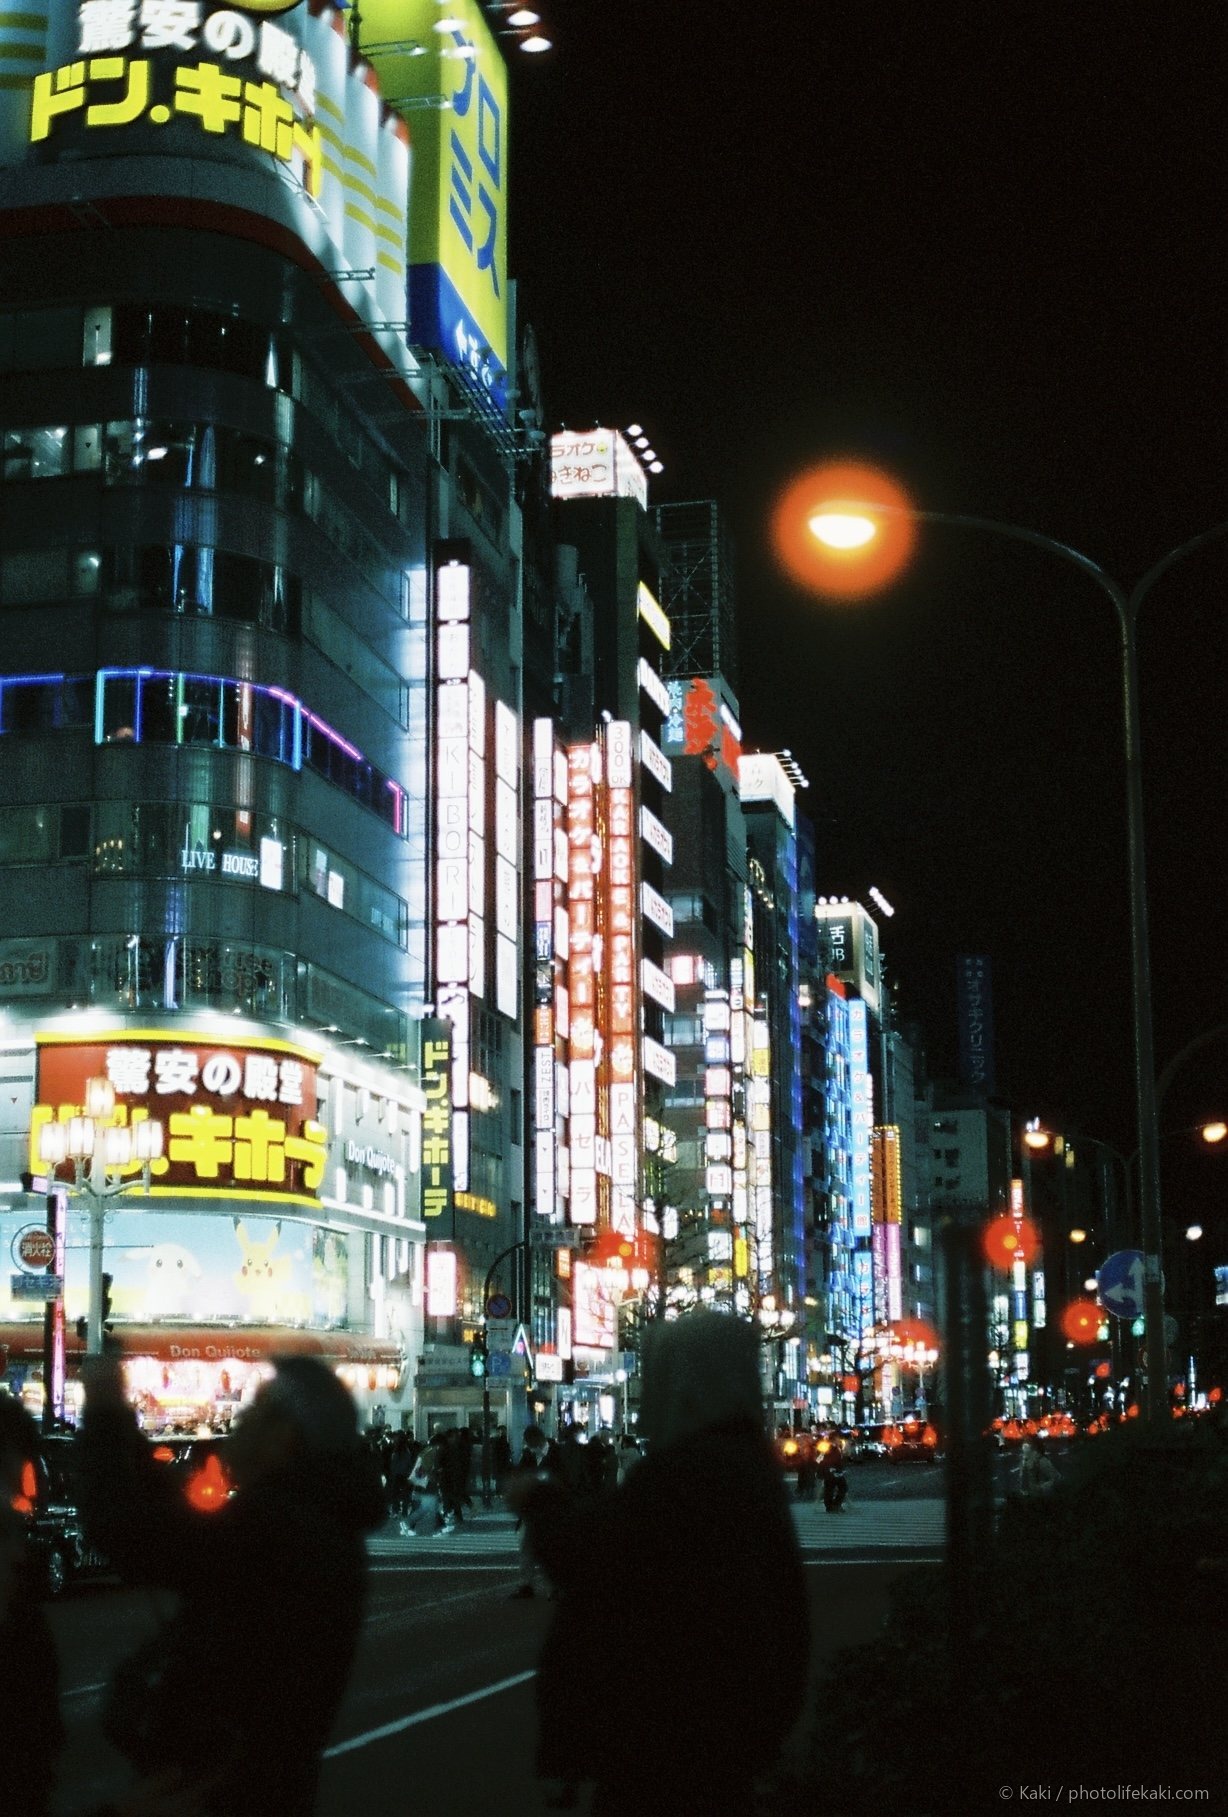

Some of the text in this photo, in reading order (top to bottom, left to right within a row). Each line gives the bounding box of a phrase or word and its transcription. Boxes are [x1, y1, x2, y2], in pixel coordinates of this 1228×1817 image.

[181, 849, 258, 877] LIVE HOUSE
[170, 1345, 261, 1358] Don Quijote
